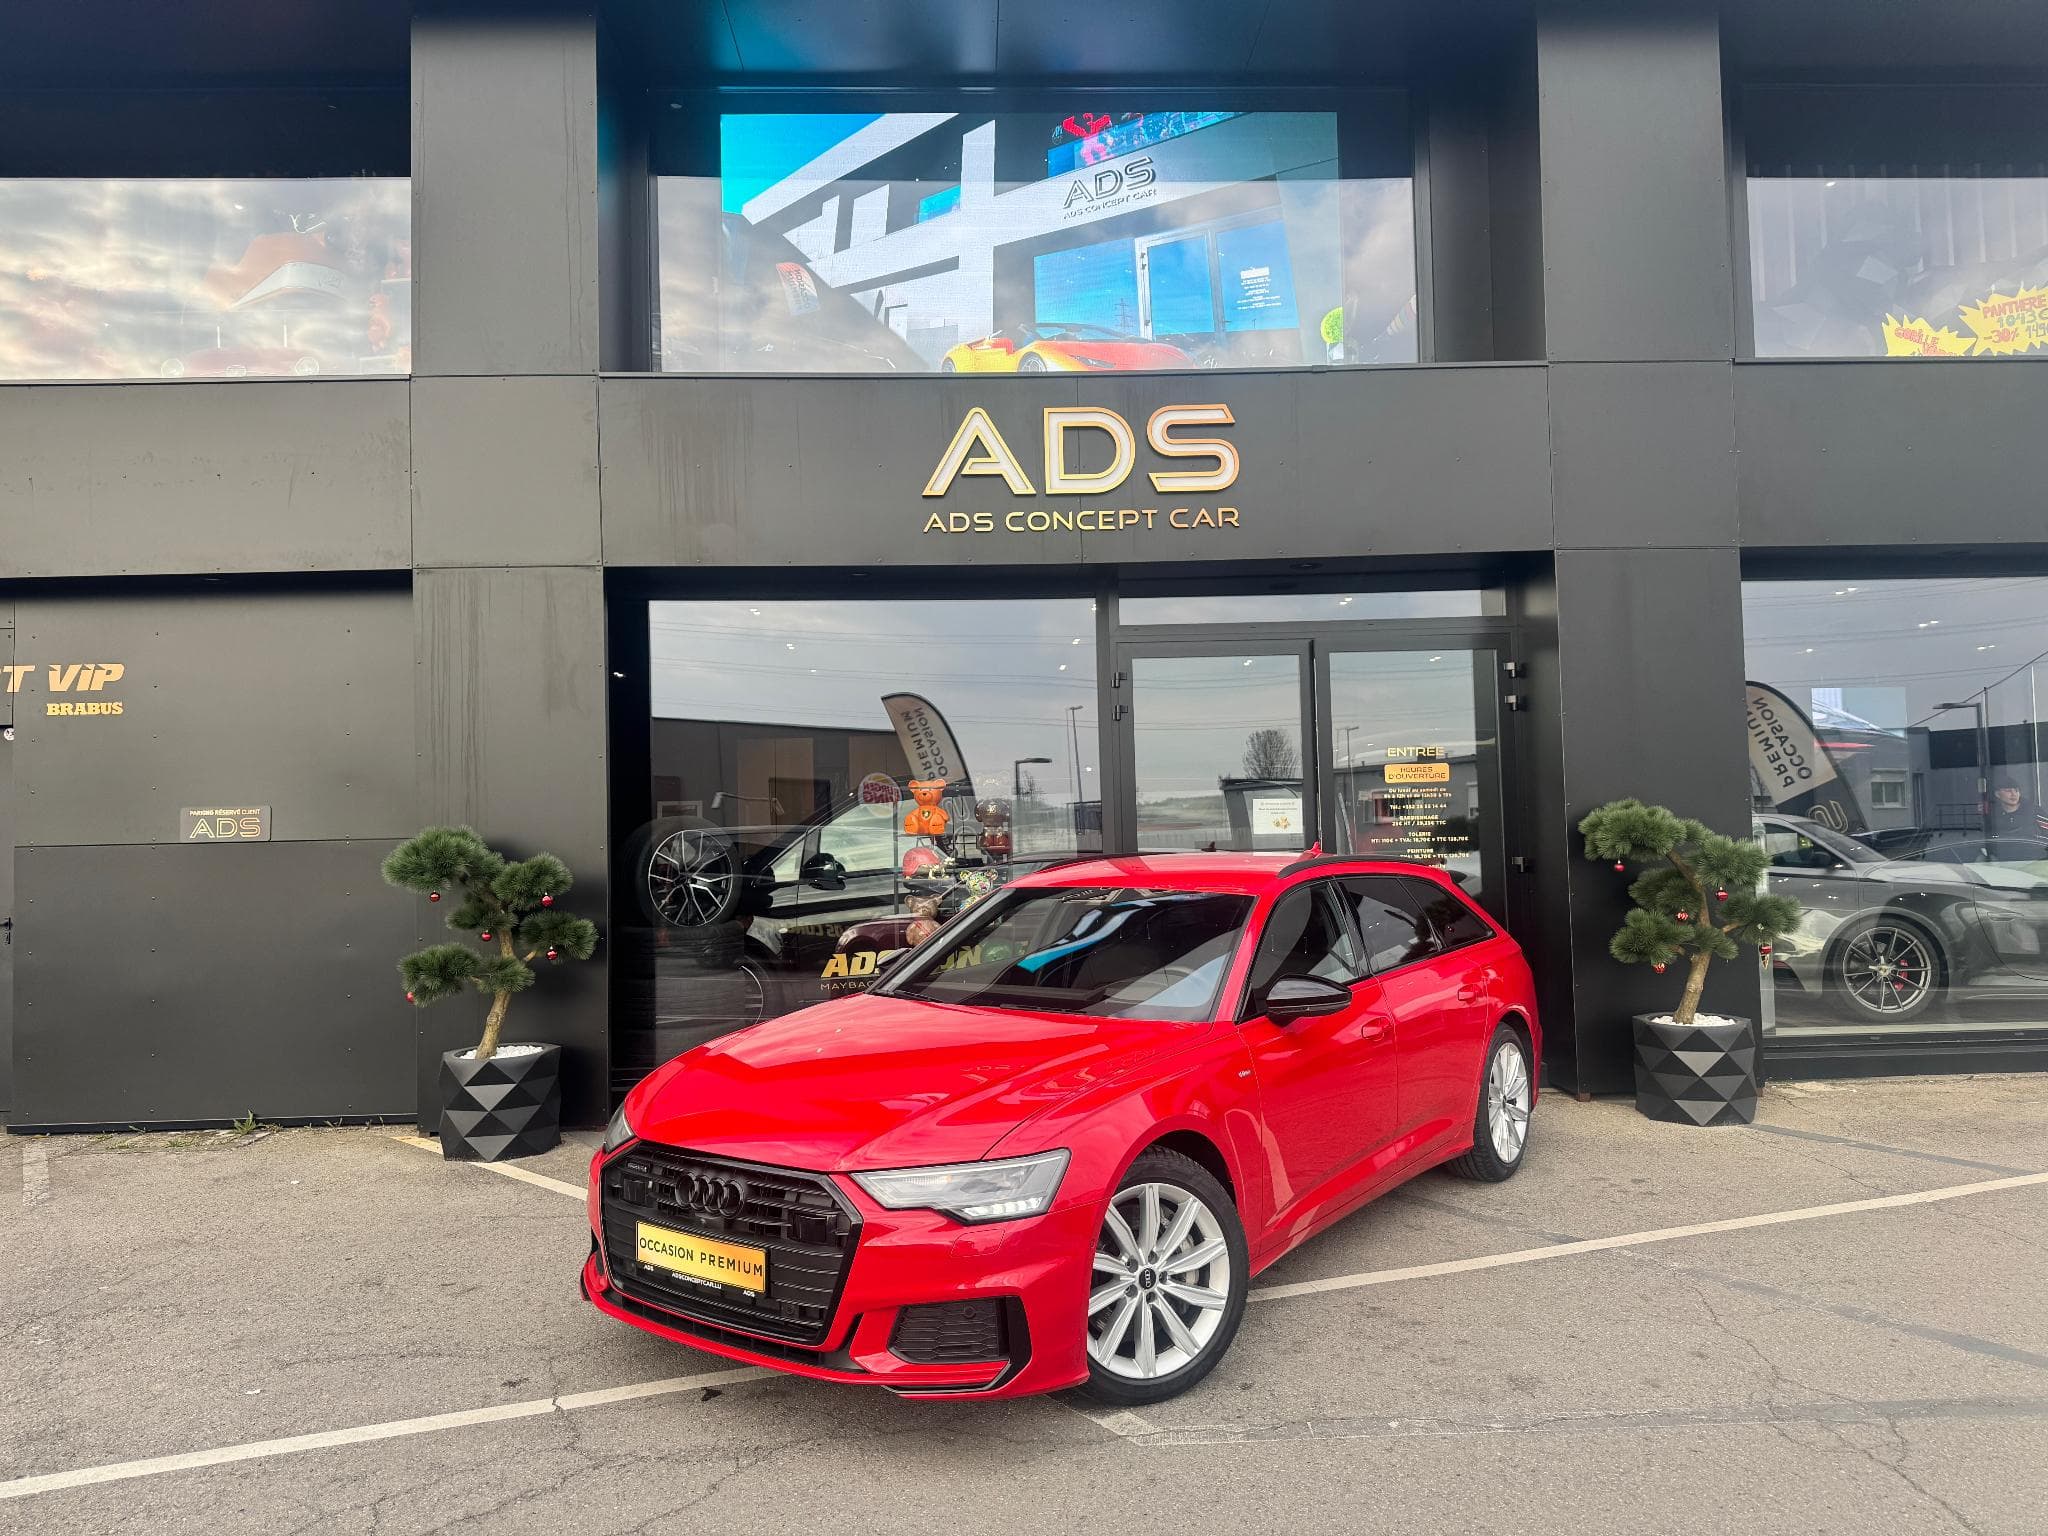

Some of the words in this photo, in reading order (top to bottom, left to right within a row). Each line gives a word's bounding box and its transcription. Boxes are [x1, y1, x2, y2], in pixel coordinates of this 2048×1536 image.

[1062, 156, 1156, 209] ADS
[922, 404, 1240, 496] ADS
[923, 512, 994, 533] ADS
[1005, 509, 1158, 532] CONCEPT
[1169, 507, 1240, 529] CAR
[46, 702, 124, 716] BRABUS
[1388, 772, 1446, 780] D'OUVERTURE
[241, 808, 260, 816] CLIENT
[189, 817, 261, 839] ADS
[639, 1237, 694, 1262] OCCASION
[700, 1252, 763, 1277] PREMIUM
